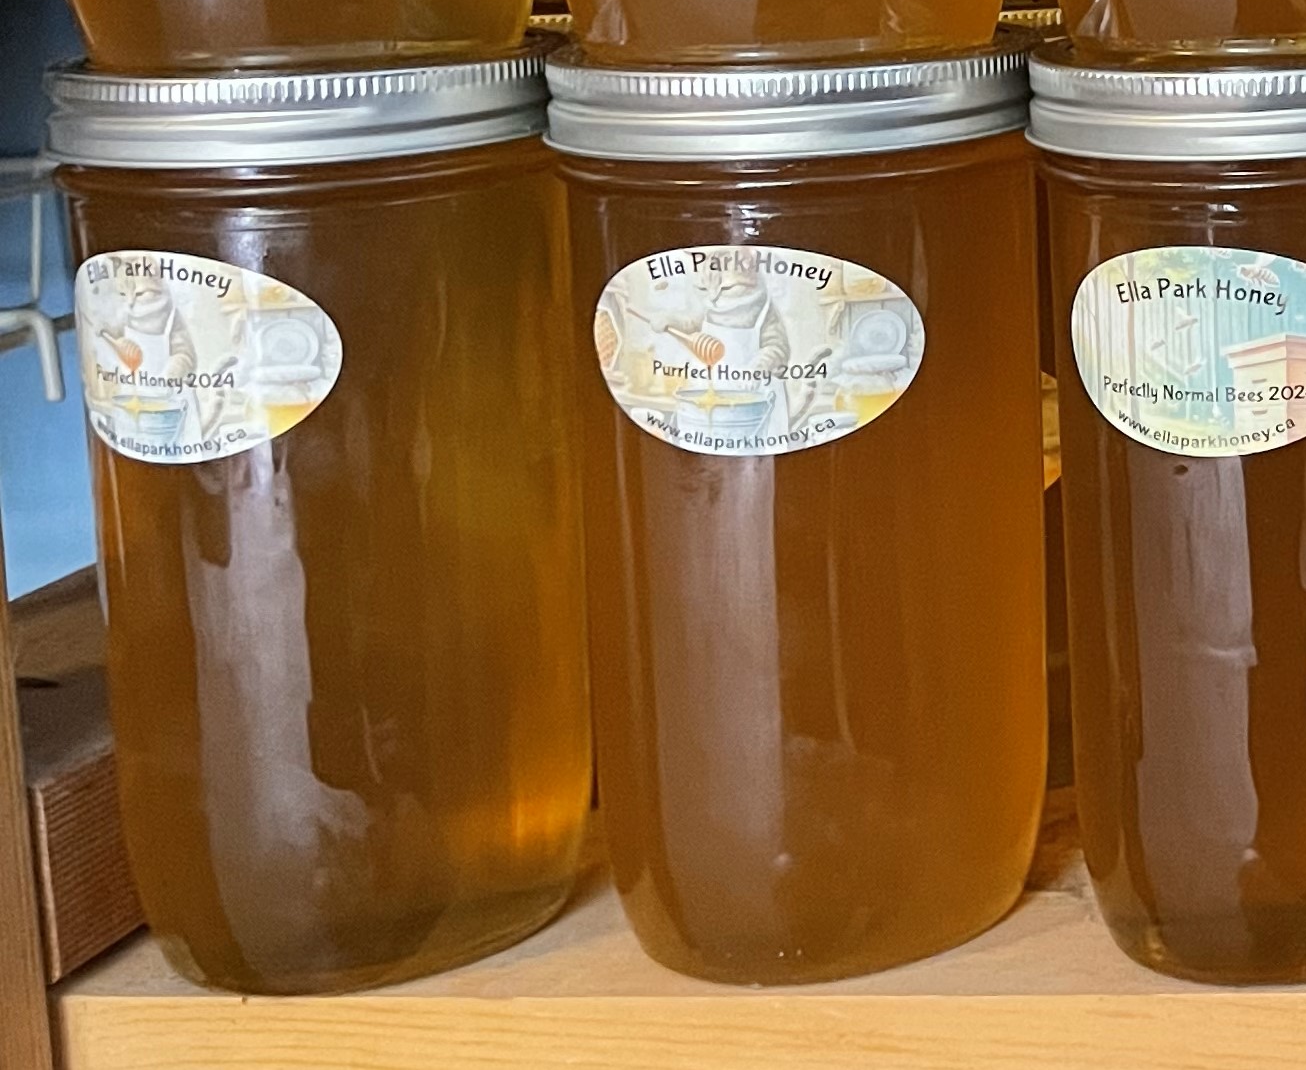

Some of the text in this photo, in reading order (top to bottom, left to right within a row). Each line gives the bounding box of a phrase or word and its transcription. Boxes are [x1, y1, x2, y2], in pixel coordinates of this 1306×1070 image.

[87, 257, 232, 298] Ella Park Honey
[647, 252, 832, 290] Ella Park Honey
[1116, 278, 1289, 315] Ella Park Honey
[139, 371, 183, 394] Honey
[188, 373, 235, 388] 2024
[653, 361, 827, 386] Purrfect Honey 2024
[1104, 376, 1158, 403] Perfectly
[1163, 385, 1219, 402] Normal
[1225, 387, 1264, 403] Bees
[646, 412, 835, 450] www.ellaparkhoney.ca
[1118, 409, 1295, 450] www.ellaparkhoney.ca
